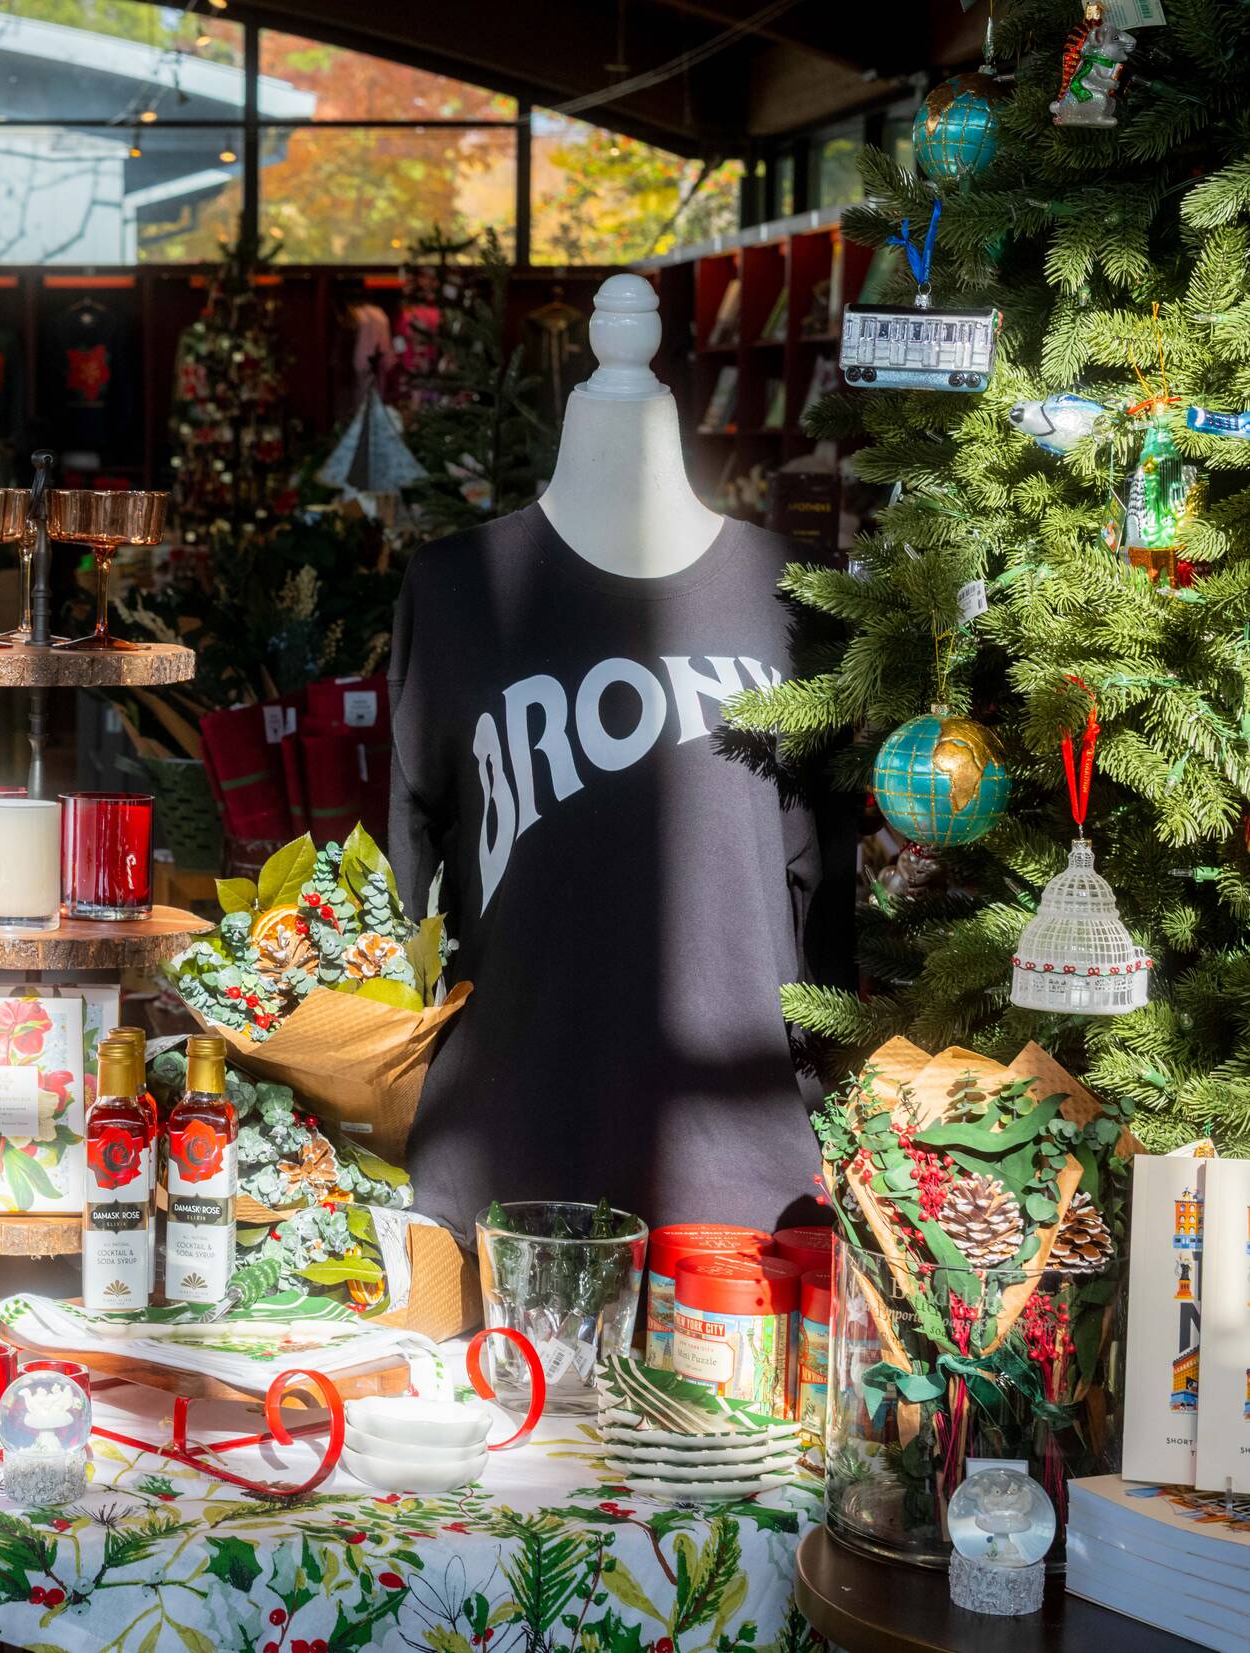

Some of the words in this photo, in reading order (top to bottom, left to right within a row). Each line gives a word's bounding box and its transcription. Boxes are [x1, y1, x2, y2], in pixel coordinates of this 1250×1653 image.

[174, 1203, 199, 1213] DAMASK
[202, 1206, 221, 1215] ROSE
[93, 1212, 120, 1220] DAMASK
[122, 1211, 140, 1219] ROSE
[176, 1241, 205, 1250] COCKTAIL
[97, 1249, 126, 1257] COCKTAIL
[128, 1249, 134, 1257] &
[176, 1249, 194, 1257] SODA
[196, 1250, 215, 1258] SYRUP
[97, 1257, 116, 1265] SODA
[117, 1257, 138, 1265] SYRUP
[687, 1319, 703, 1333] YORK
[705, 1322, 724, 1336] CITY
[691, 1352, 718, 1367] Puzzle
[1166, 1437, 1194, 1446] SHORT
